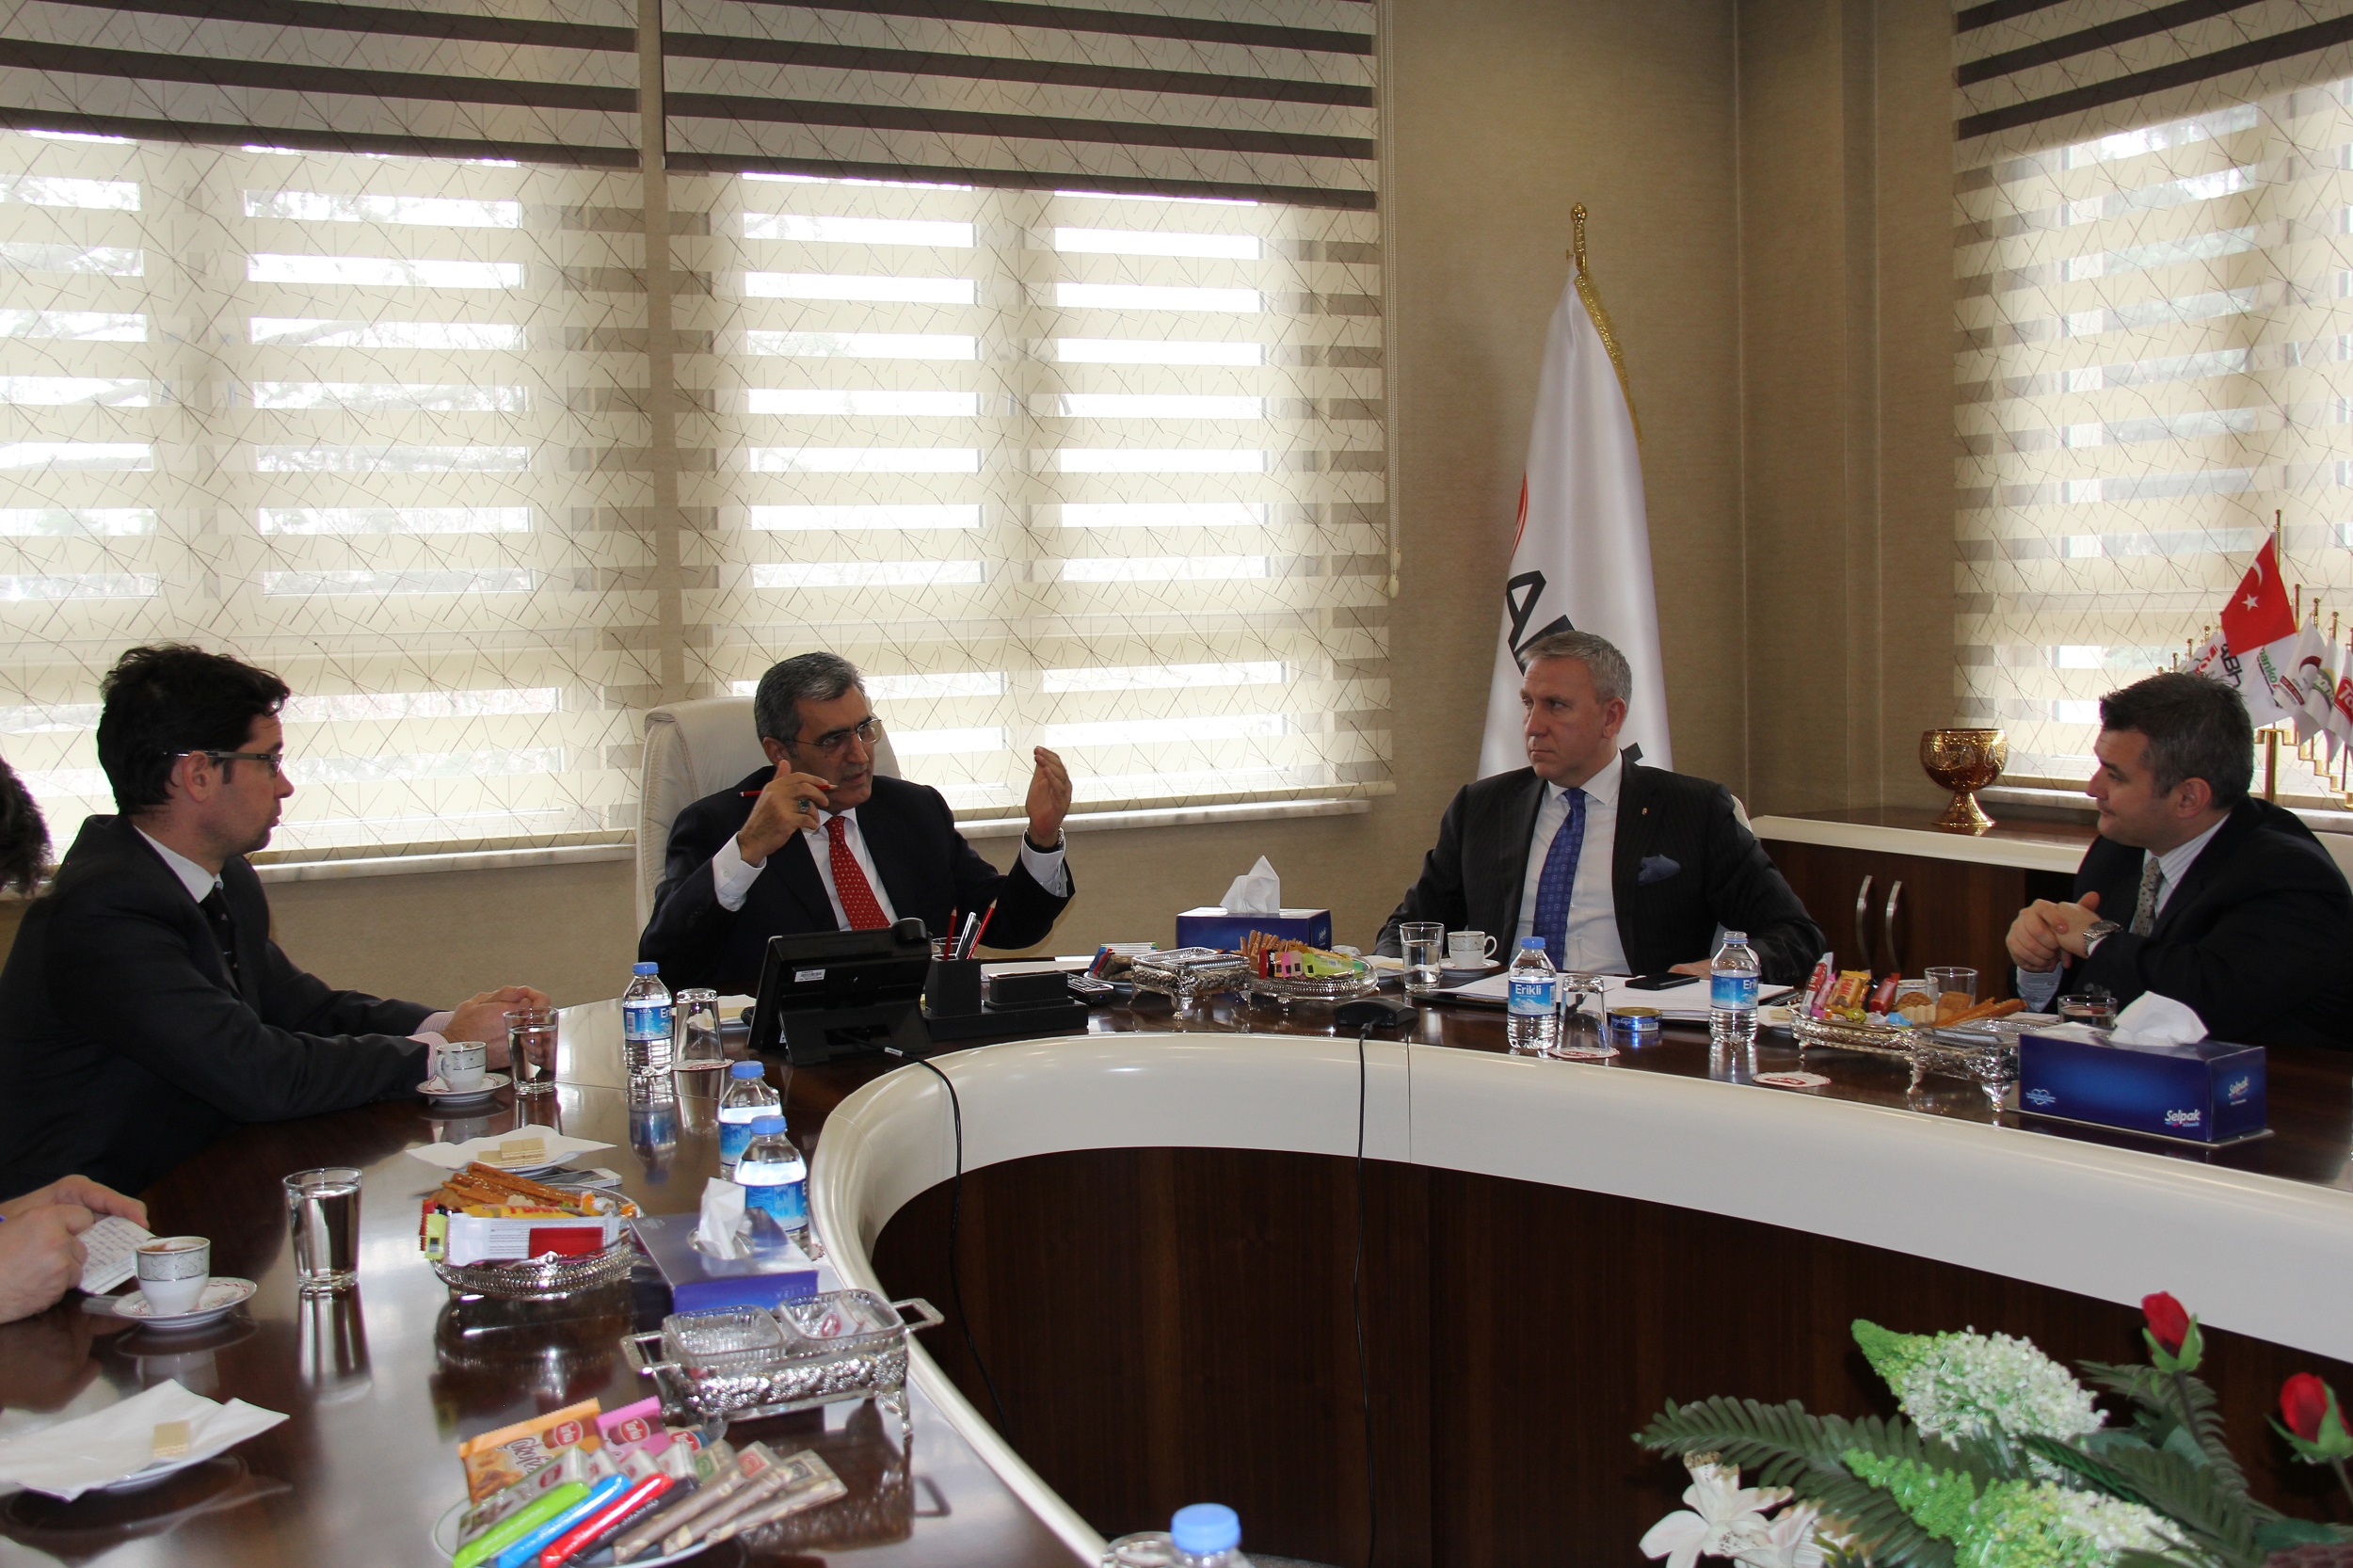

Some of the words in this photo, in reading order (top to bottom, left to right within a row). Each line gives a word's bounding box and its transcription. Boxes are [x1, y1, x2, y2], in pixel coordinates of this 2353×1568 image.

[1515, 984, 1542, 996] Erikli
[2165, 1109, 2201, 1125] Selpak
[625, 1419, 642, 1441] Torku
